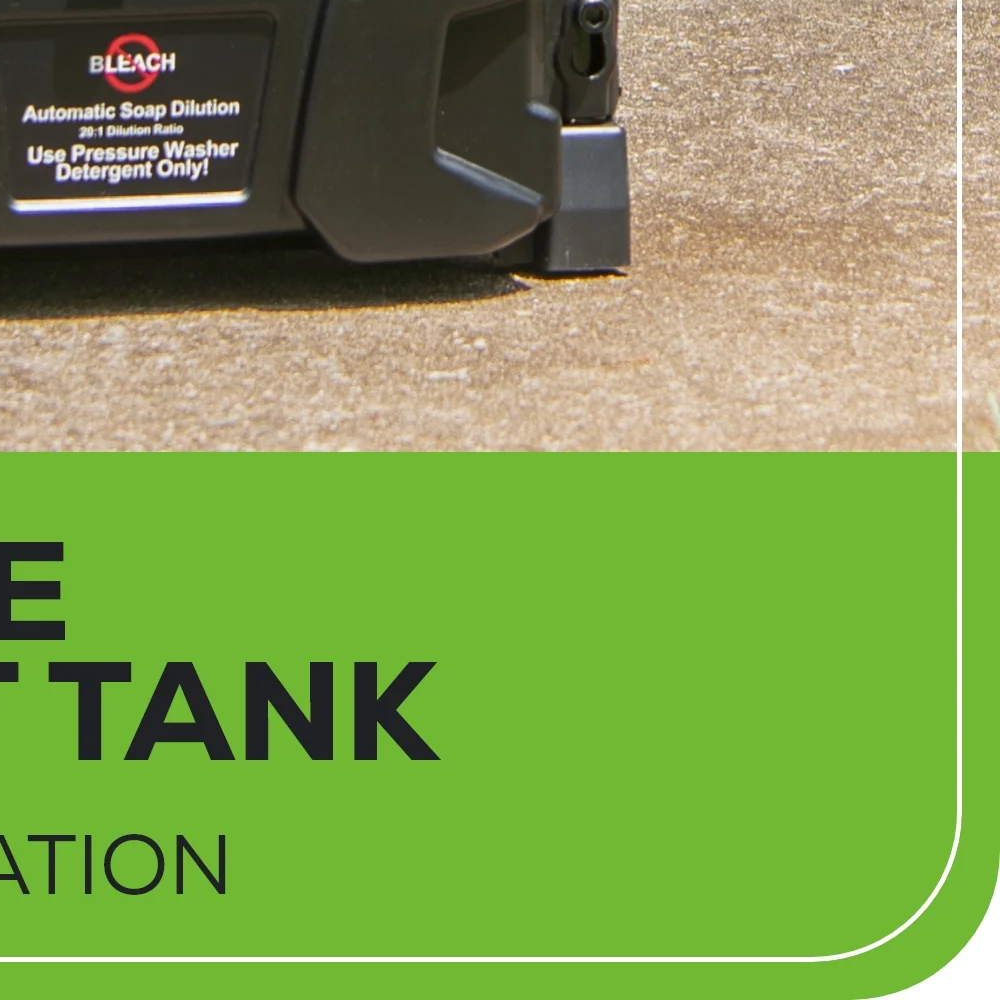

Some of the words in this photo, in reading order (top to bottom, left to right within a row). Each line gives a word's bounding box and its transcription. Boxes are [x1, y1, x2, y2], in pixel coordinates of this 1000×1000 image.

[89, 53, 176, 74] BLEACH
[22, 103, 116, 123] Automatic
[119, 101, 167, 121] Soap
[170, 99, 240, 117] Dilution
[78, 125, 103, 138] 20:1
[106, 124, 151, 137] Dilution
[153, 123, 184, 136] Ratio
[27, 146, 66, 164] Use
[70, 143, 160, 163] Pressure
[163, 140, 239, 159] Washer
[55, 160, 153, 183] Detergent
[156, 158, 209, 181] Only!
